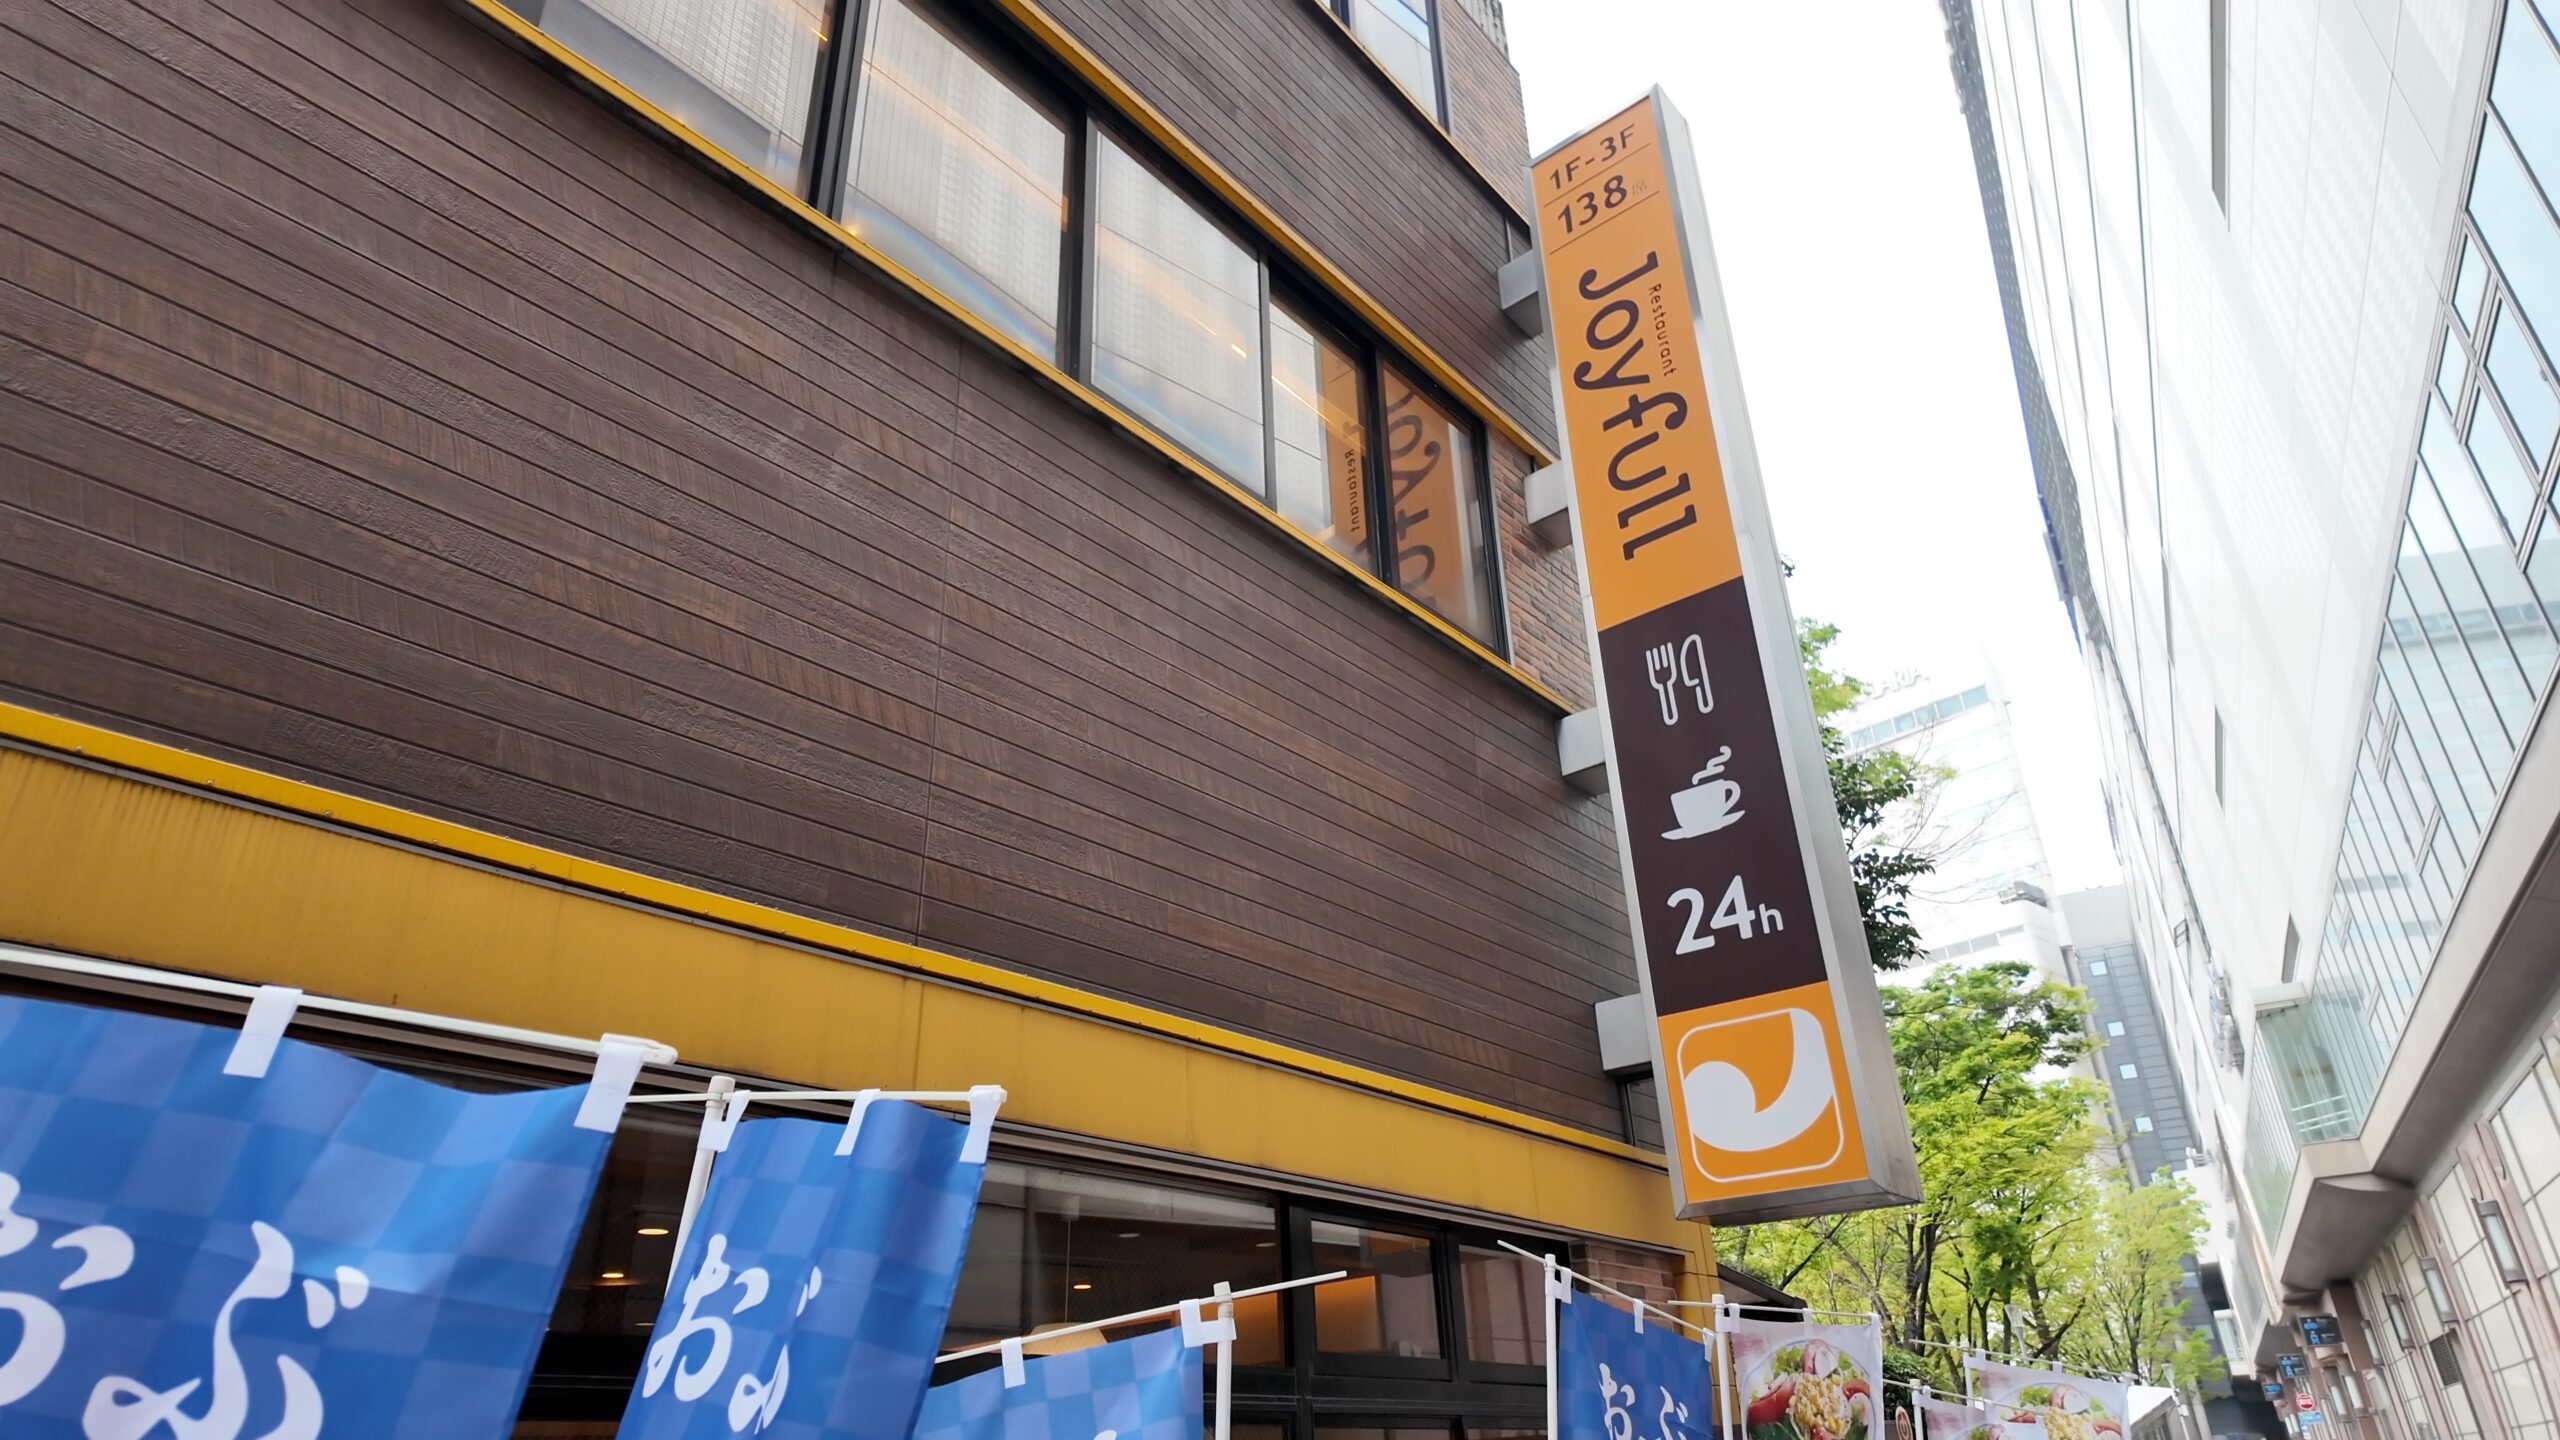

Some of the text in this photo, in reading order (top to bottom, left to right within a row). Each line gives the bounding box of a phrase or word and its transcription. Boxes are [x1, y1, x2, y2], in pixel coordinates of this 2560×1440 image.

[1549, 123, 1635, 190] 1F-3F
[1557, 174, 1628, 234] 138
[1648, 283, 1677, 377] Restaurant
[1573, 250, 1698, 561] Joyfull
[1666, 874, 1784, 956] 24h
